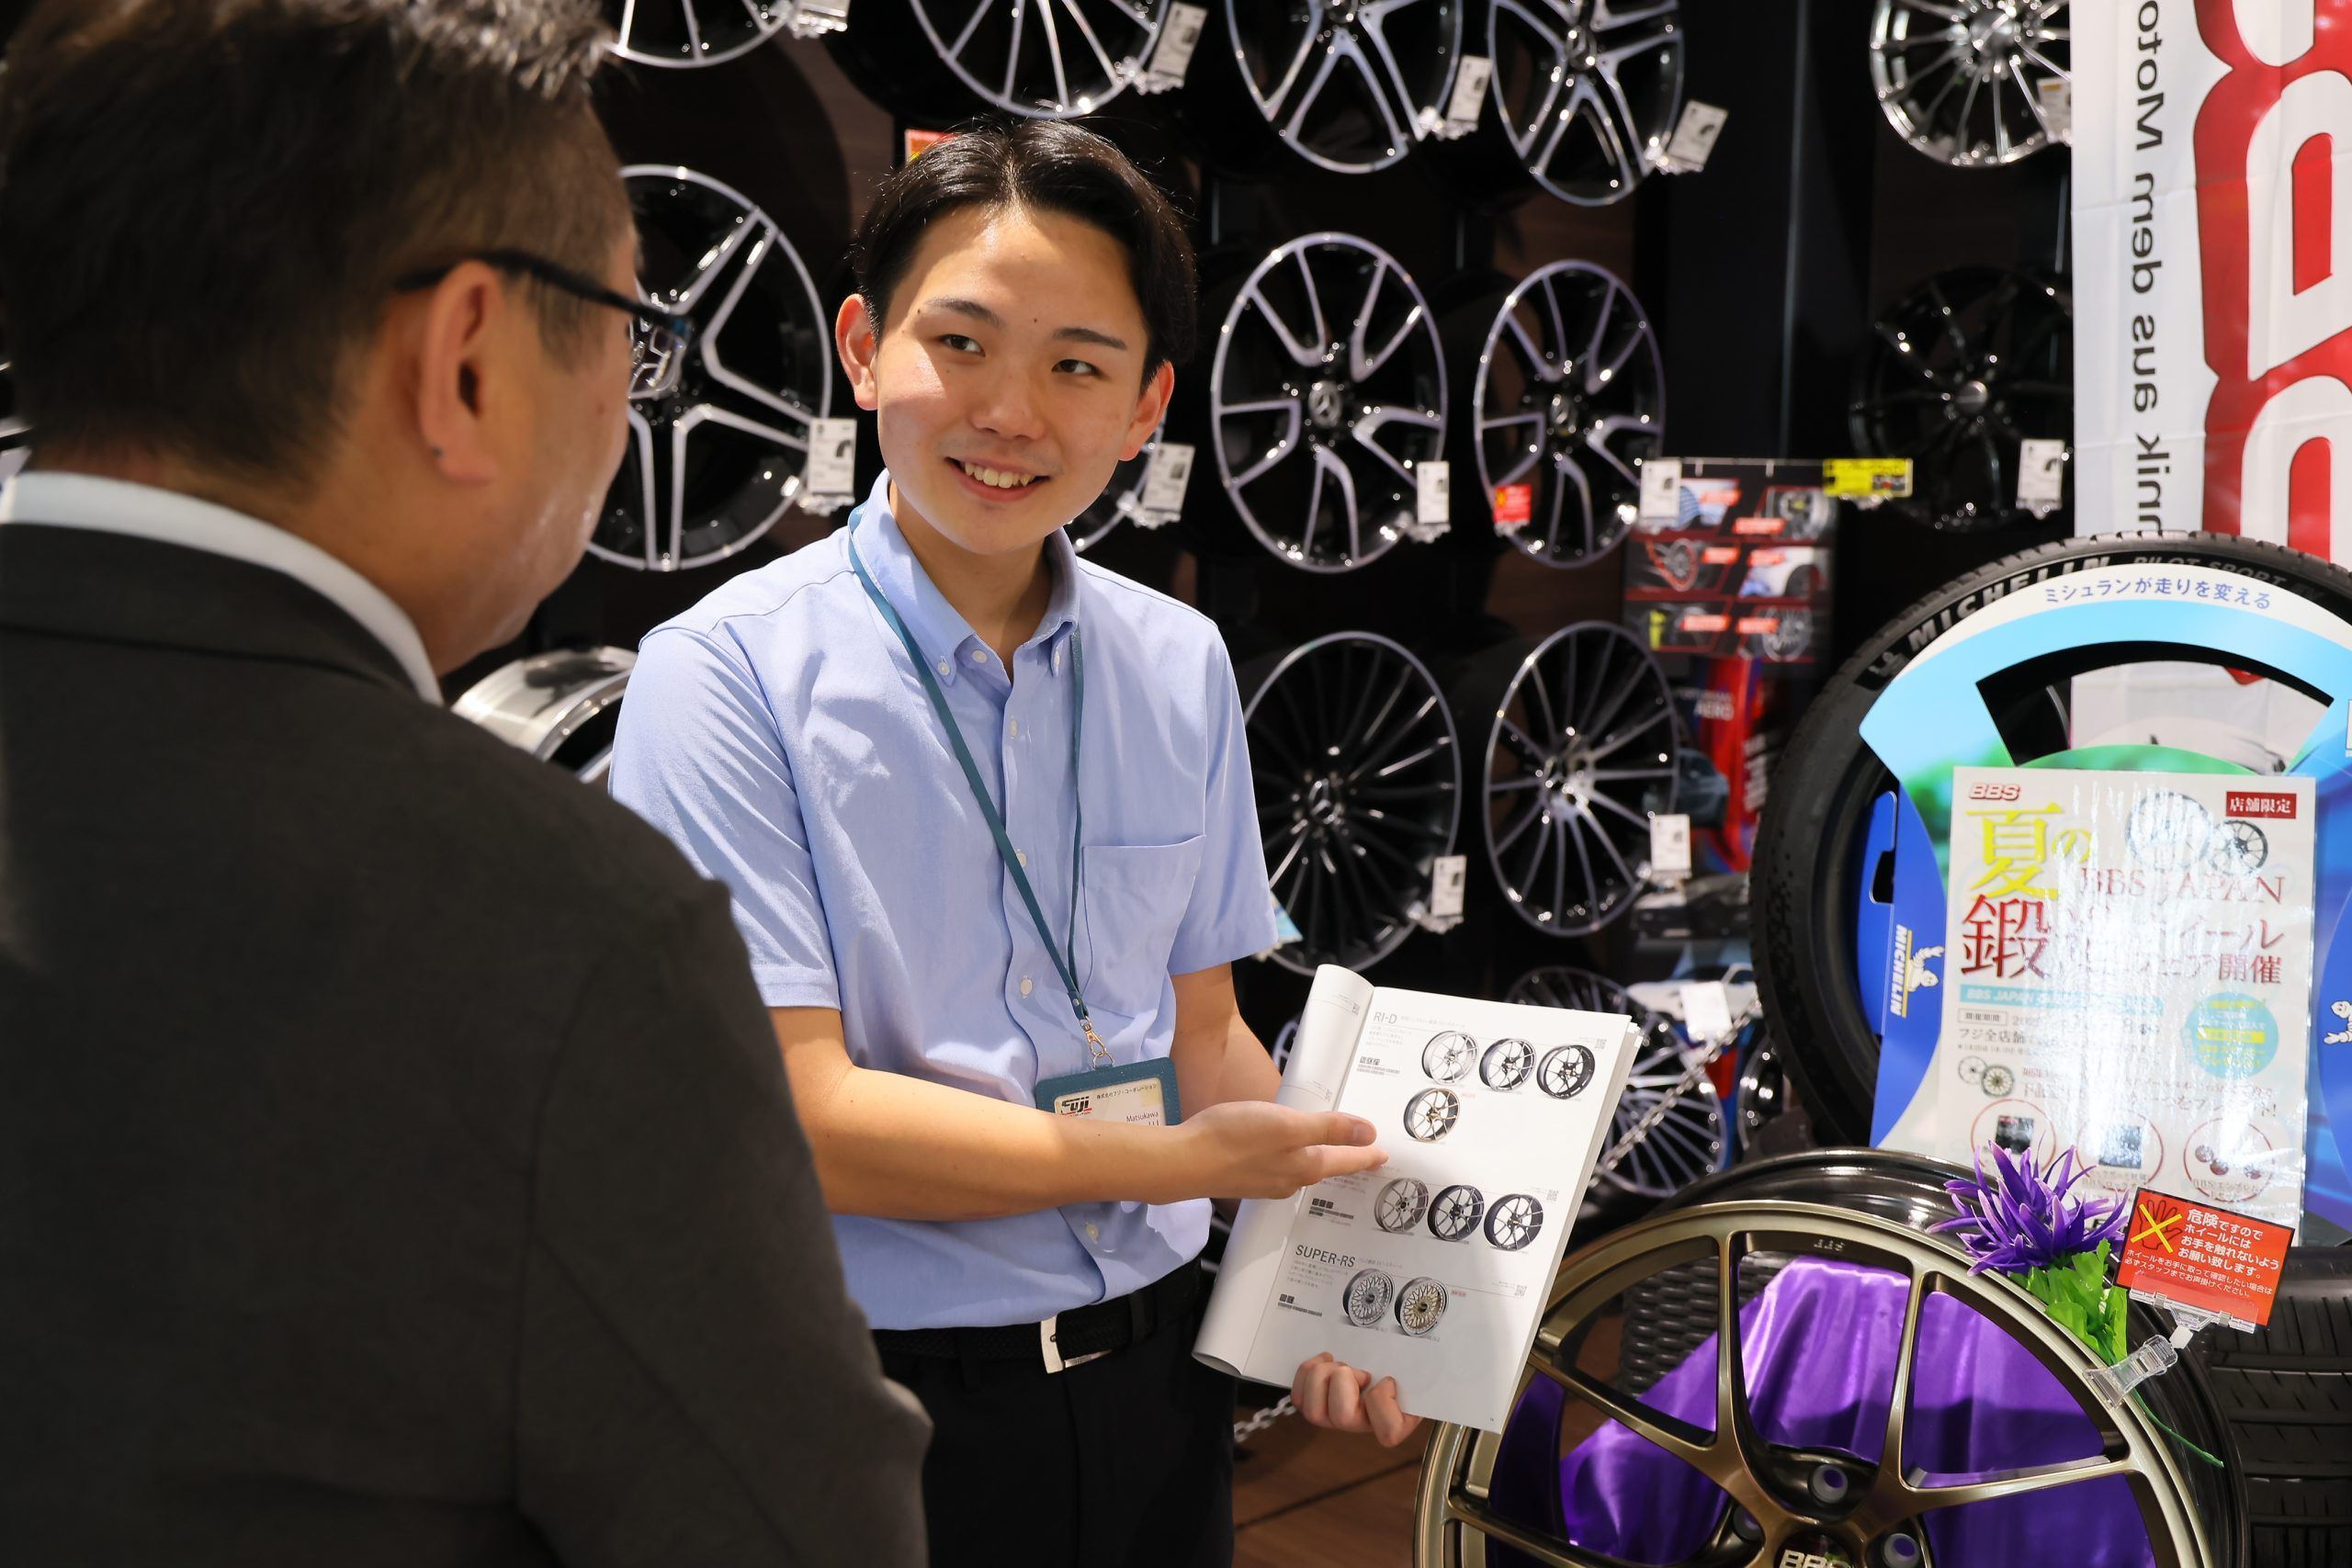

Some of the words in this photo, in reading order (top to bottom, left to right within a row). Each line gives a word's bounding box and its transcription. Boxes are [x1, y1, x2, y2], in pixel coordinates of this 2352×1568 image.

[2045, 577, 2270, 610] ミシュランが走りを変える
[1968, 784, 2020, 802] BBS
[2229, 797, 2291, 815] 店舗限定
[1890, 924, 1908, 1016] MICHELIN
[1373, 1011, 1397, 1025] RI-D
[1126, 1111, 1159, 1122] Matsukawa
[2185, 1223, 2251, 1247] ホイールには
[2186, 1208, 2263, 1237] 危険ですので
[1295, 1244, 1355, 1268] SUPER-RS
[2177, 1247, 2262, 1279] お願い致します。
[2180, 1234, 2279, 1270] お手を触れないよう
[2124, 1258, 2251, 1298] 必ずスタッフまでお声掛けください。
[2126, 1248, 2273, 1294] ホイールをお手に取って確認したい場合は
[1779, 1550, 1850, 1568] BB
